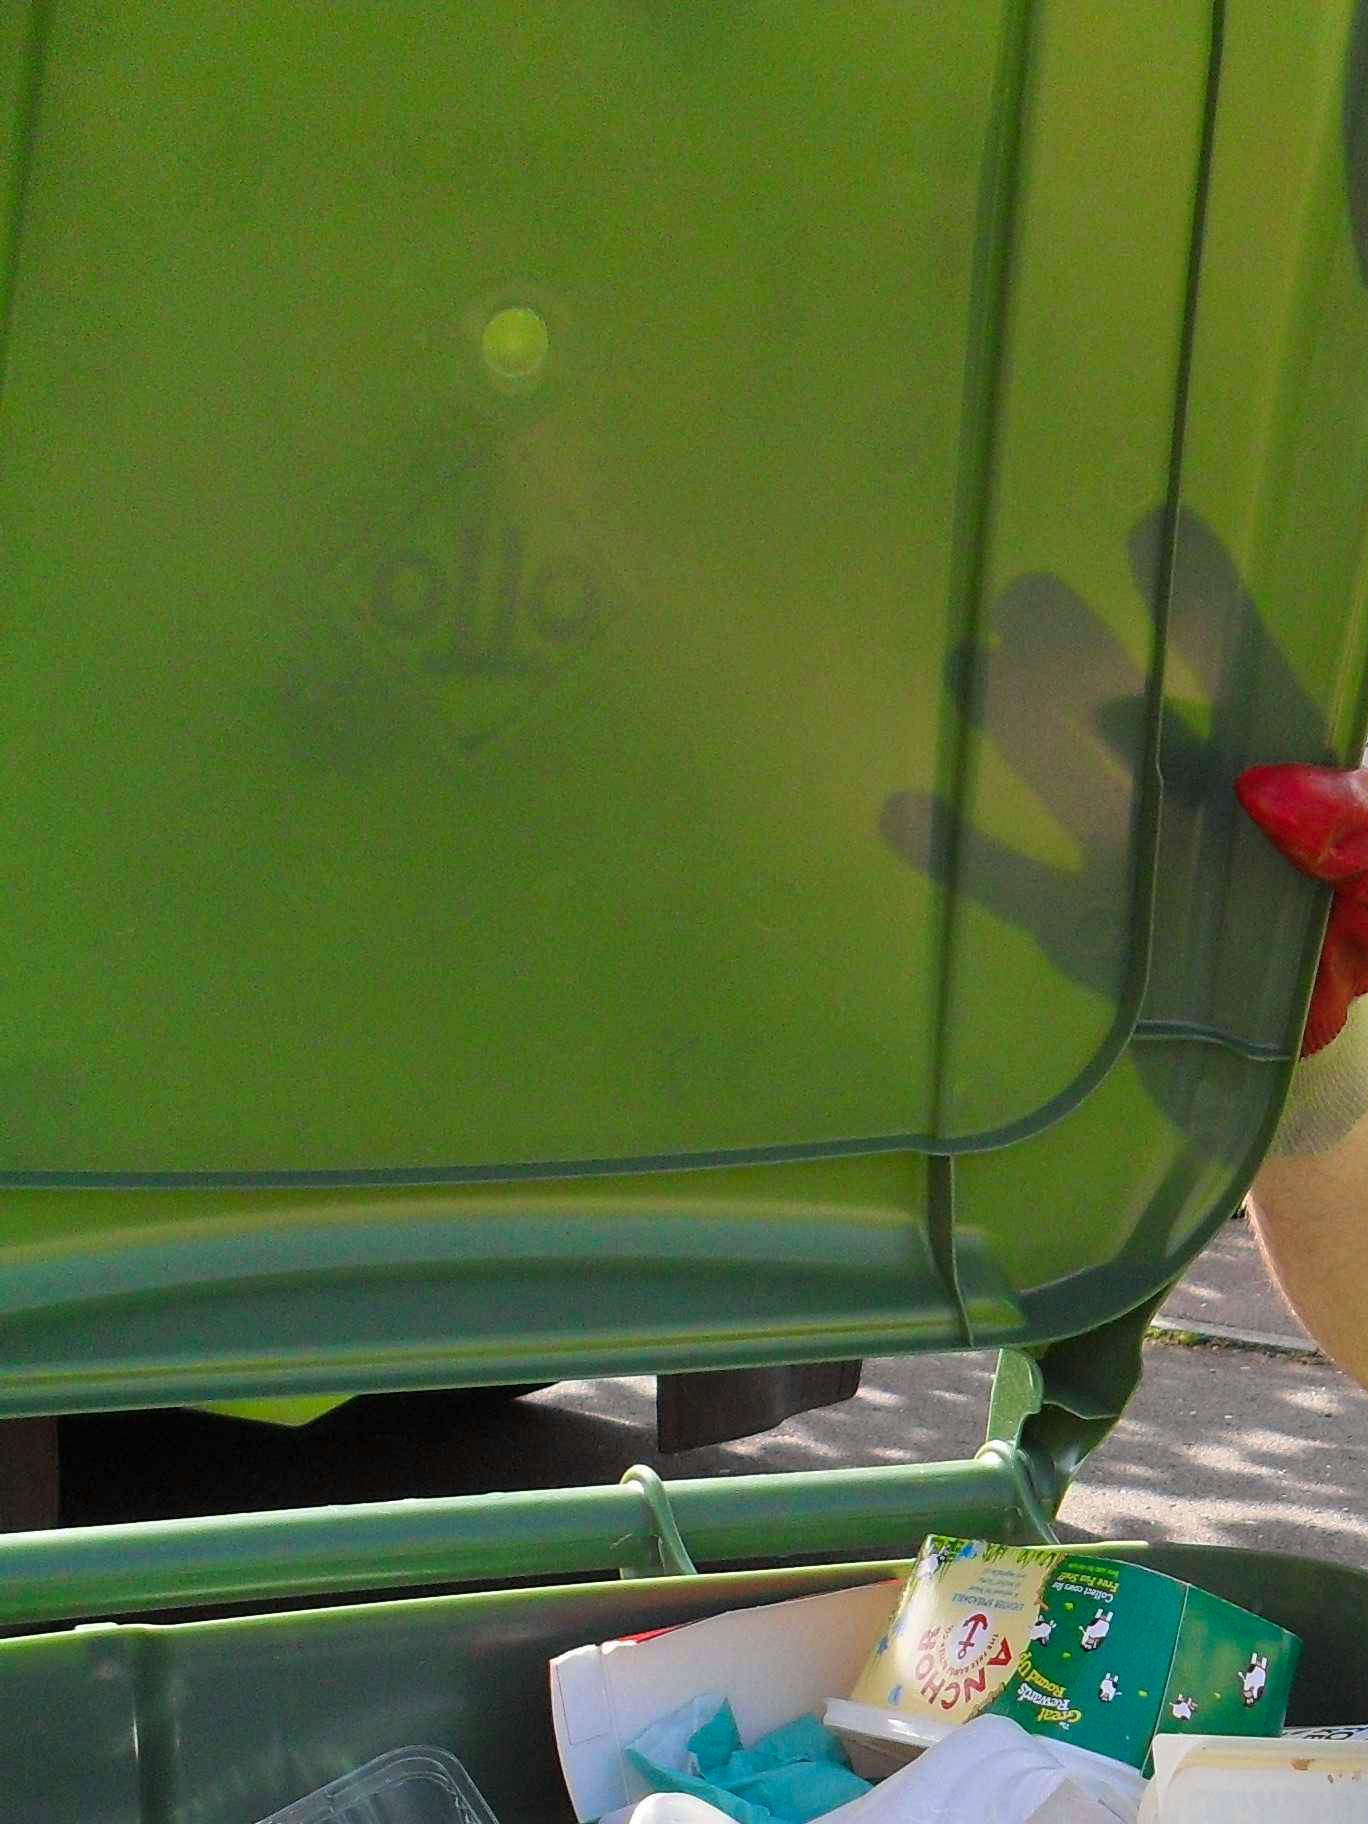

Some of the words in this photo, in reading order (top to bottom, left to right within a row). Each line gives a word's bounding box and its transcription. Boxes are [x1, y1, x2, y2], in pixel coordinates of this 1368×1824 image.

[914, 1625, 1013, 1711] ANCHOR
[1028, 1667, 1065, 1697] Round
[1016, 1681, 1069, 1710] Rewards
[1037, 1708, 1081, 1723] Great
